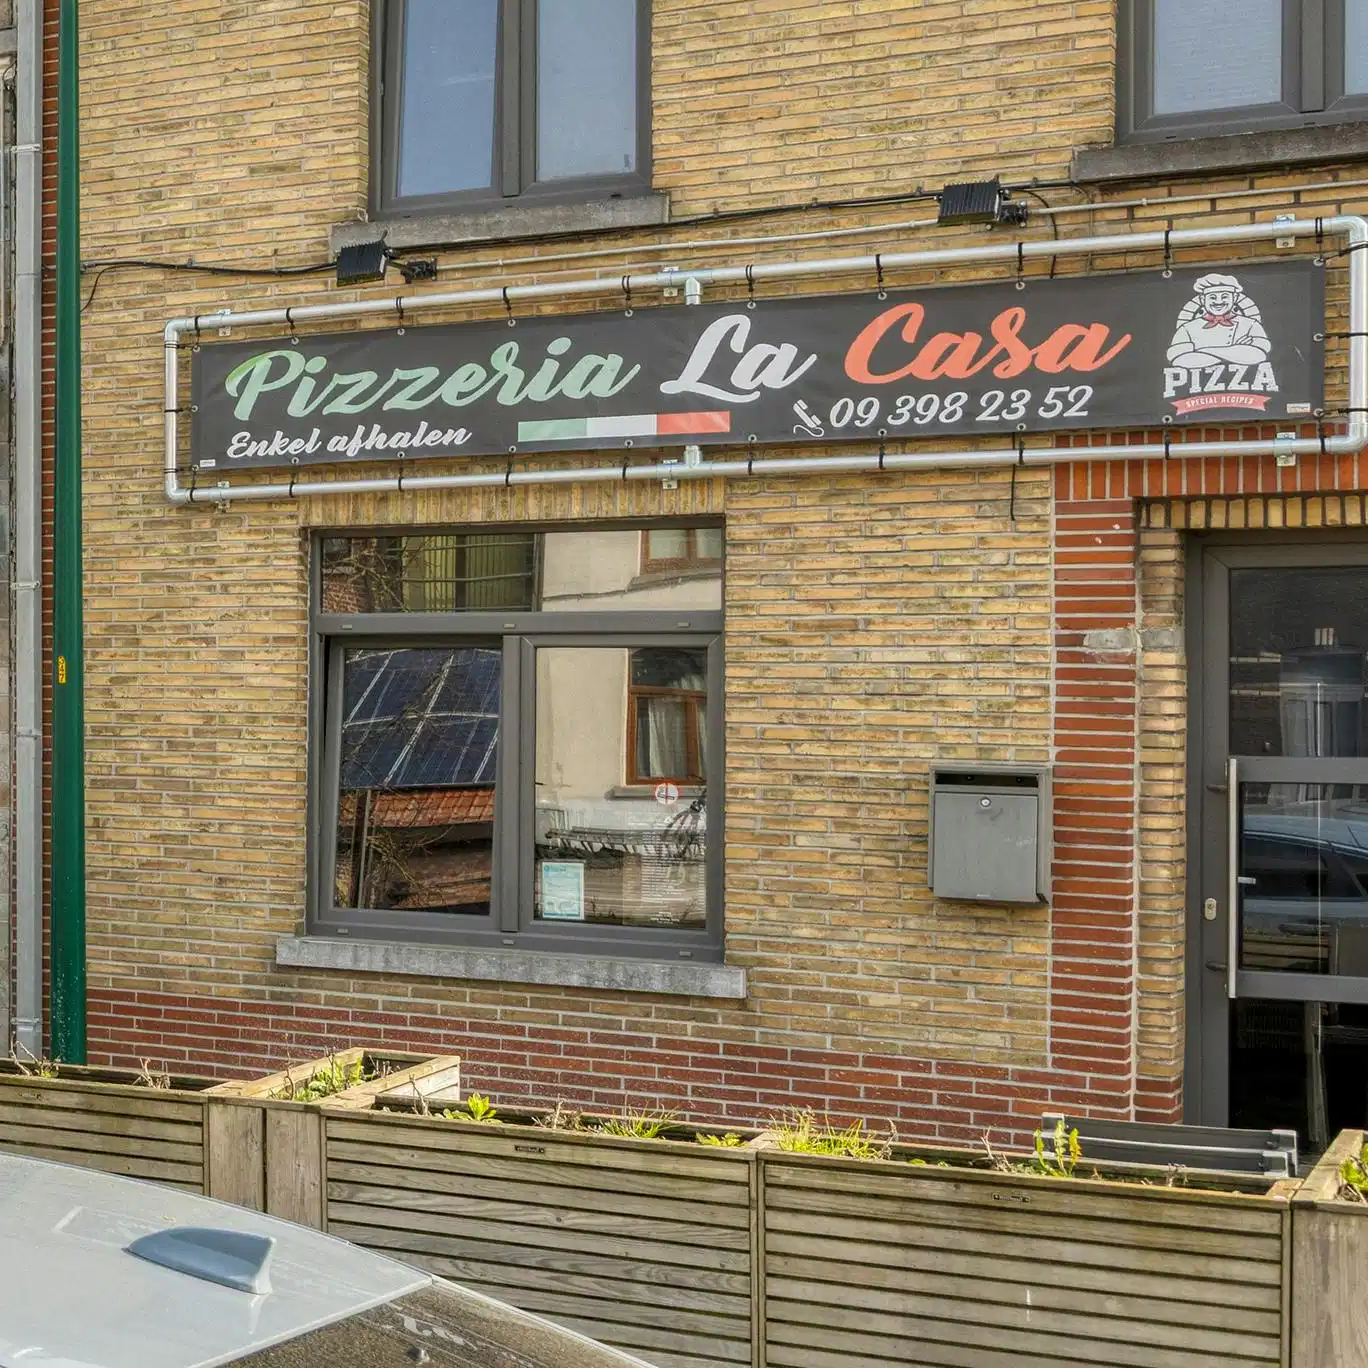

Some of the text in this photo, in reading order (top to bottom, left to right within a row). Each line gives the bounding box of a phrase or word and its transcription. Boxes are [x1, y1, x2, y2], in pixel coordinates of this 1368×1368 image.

[224, 301, 1132, 422] Pizzeria La Casa
[1163, 361, 1279, 398] PIZZA
[829, 384, 1094, 428] 09 398 23 52
[1184, 394, 1218, 408] SPECIAL
[225, 419, 473, 460] Enkel afhalen
